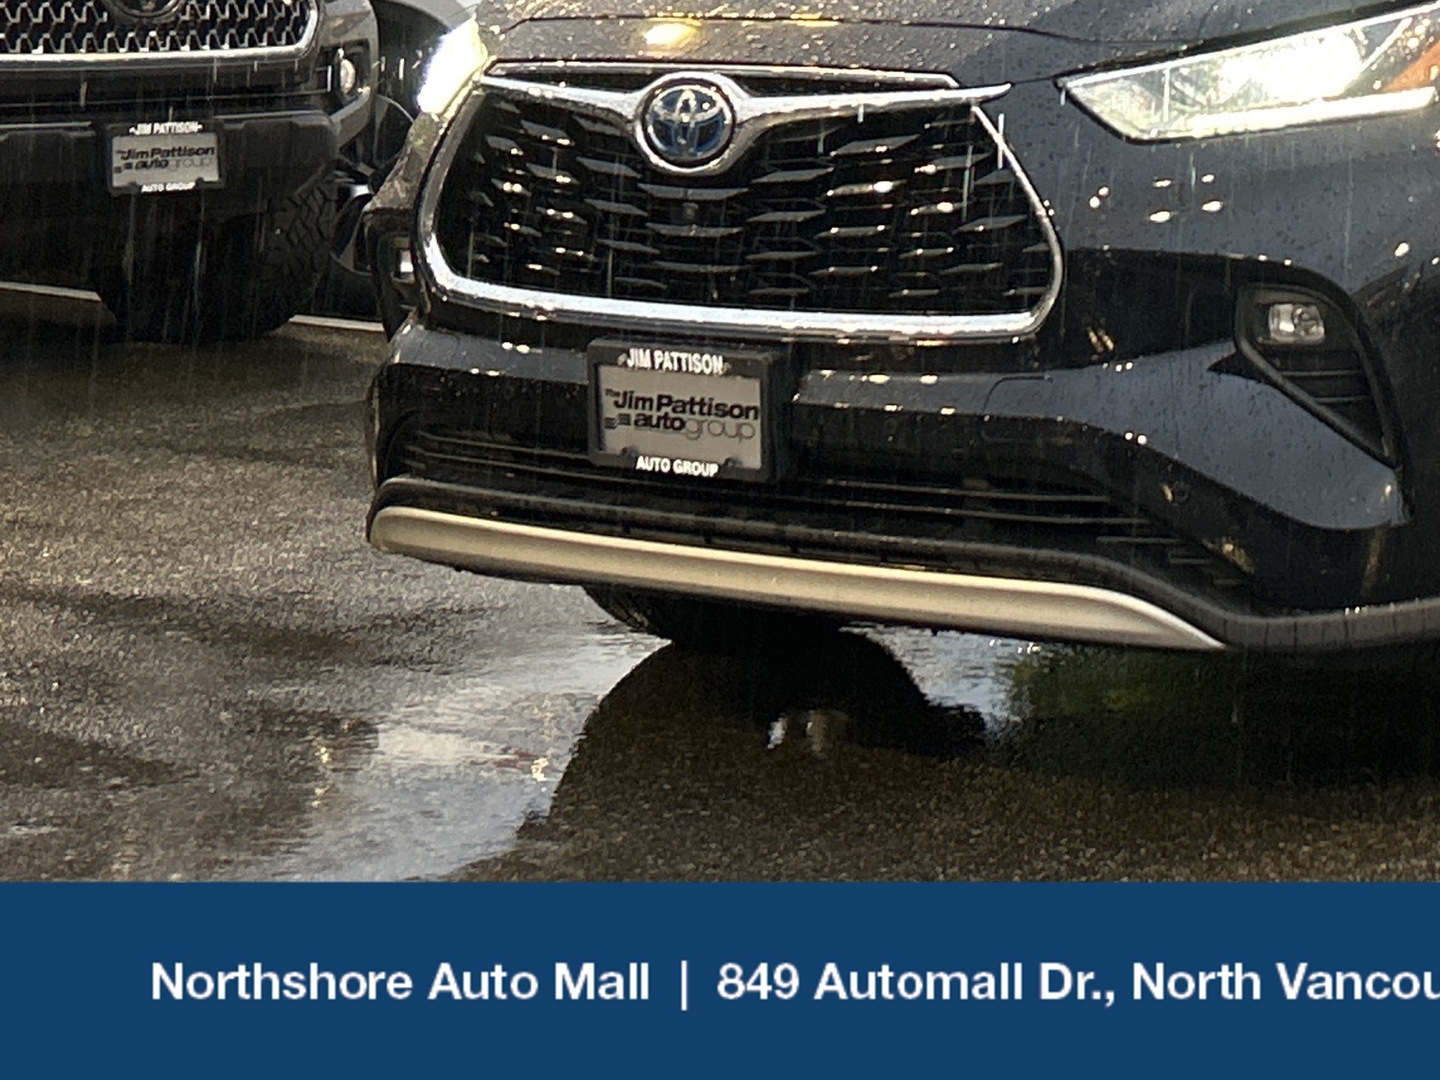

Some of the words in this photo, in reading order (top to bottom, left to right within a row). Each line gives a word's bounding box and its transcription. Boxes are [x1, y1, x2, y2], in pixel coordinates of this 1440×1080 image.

[627, 348, 651, 369] JIM
[654, 350, 724, 374] PATTISON
[614, 390, 653, 410] Jim
[657, 394, 759, 420] Pattison
[636, 456, 670, 473] AUTO
[673, 460, 719, 477] GROUP
